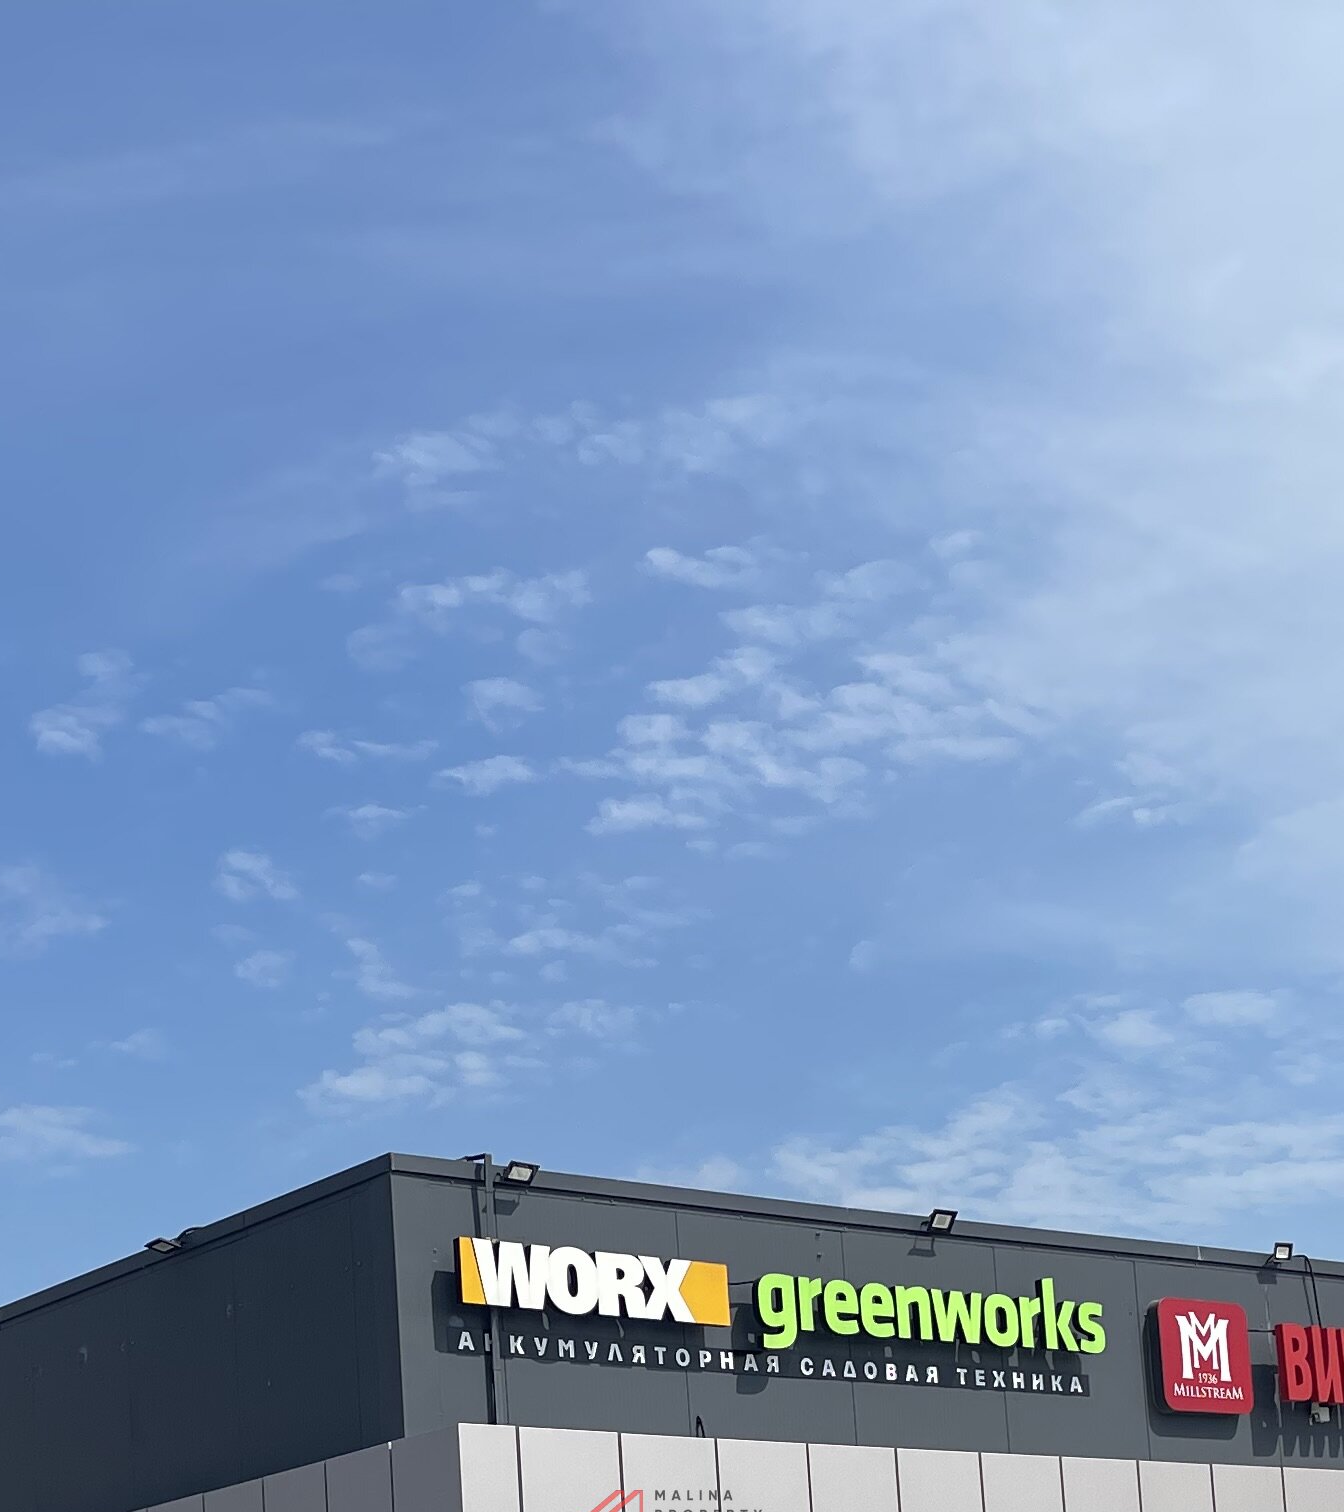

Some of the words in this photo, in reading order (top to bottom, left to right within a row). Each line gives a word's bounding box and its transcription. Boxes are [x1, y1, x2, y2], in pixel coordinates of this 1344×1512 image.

[470, 1236, 696, 1324] WORX
[757, 1272, 1107, 1354] greenworks
[800, 1357, 939, 1384] САДОВАЯ
[956, 1367, 1084, 1394] ТЕХНИКА
[1197, 1372, 1219, 1385] 1936
